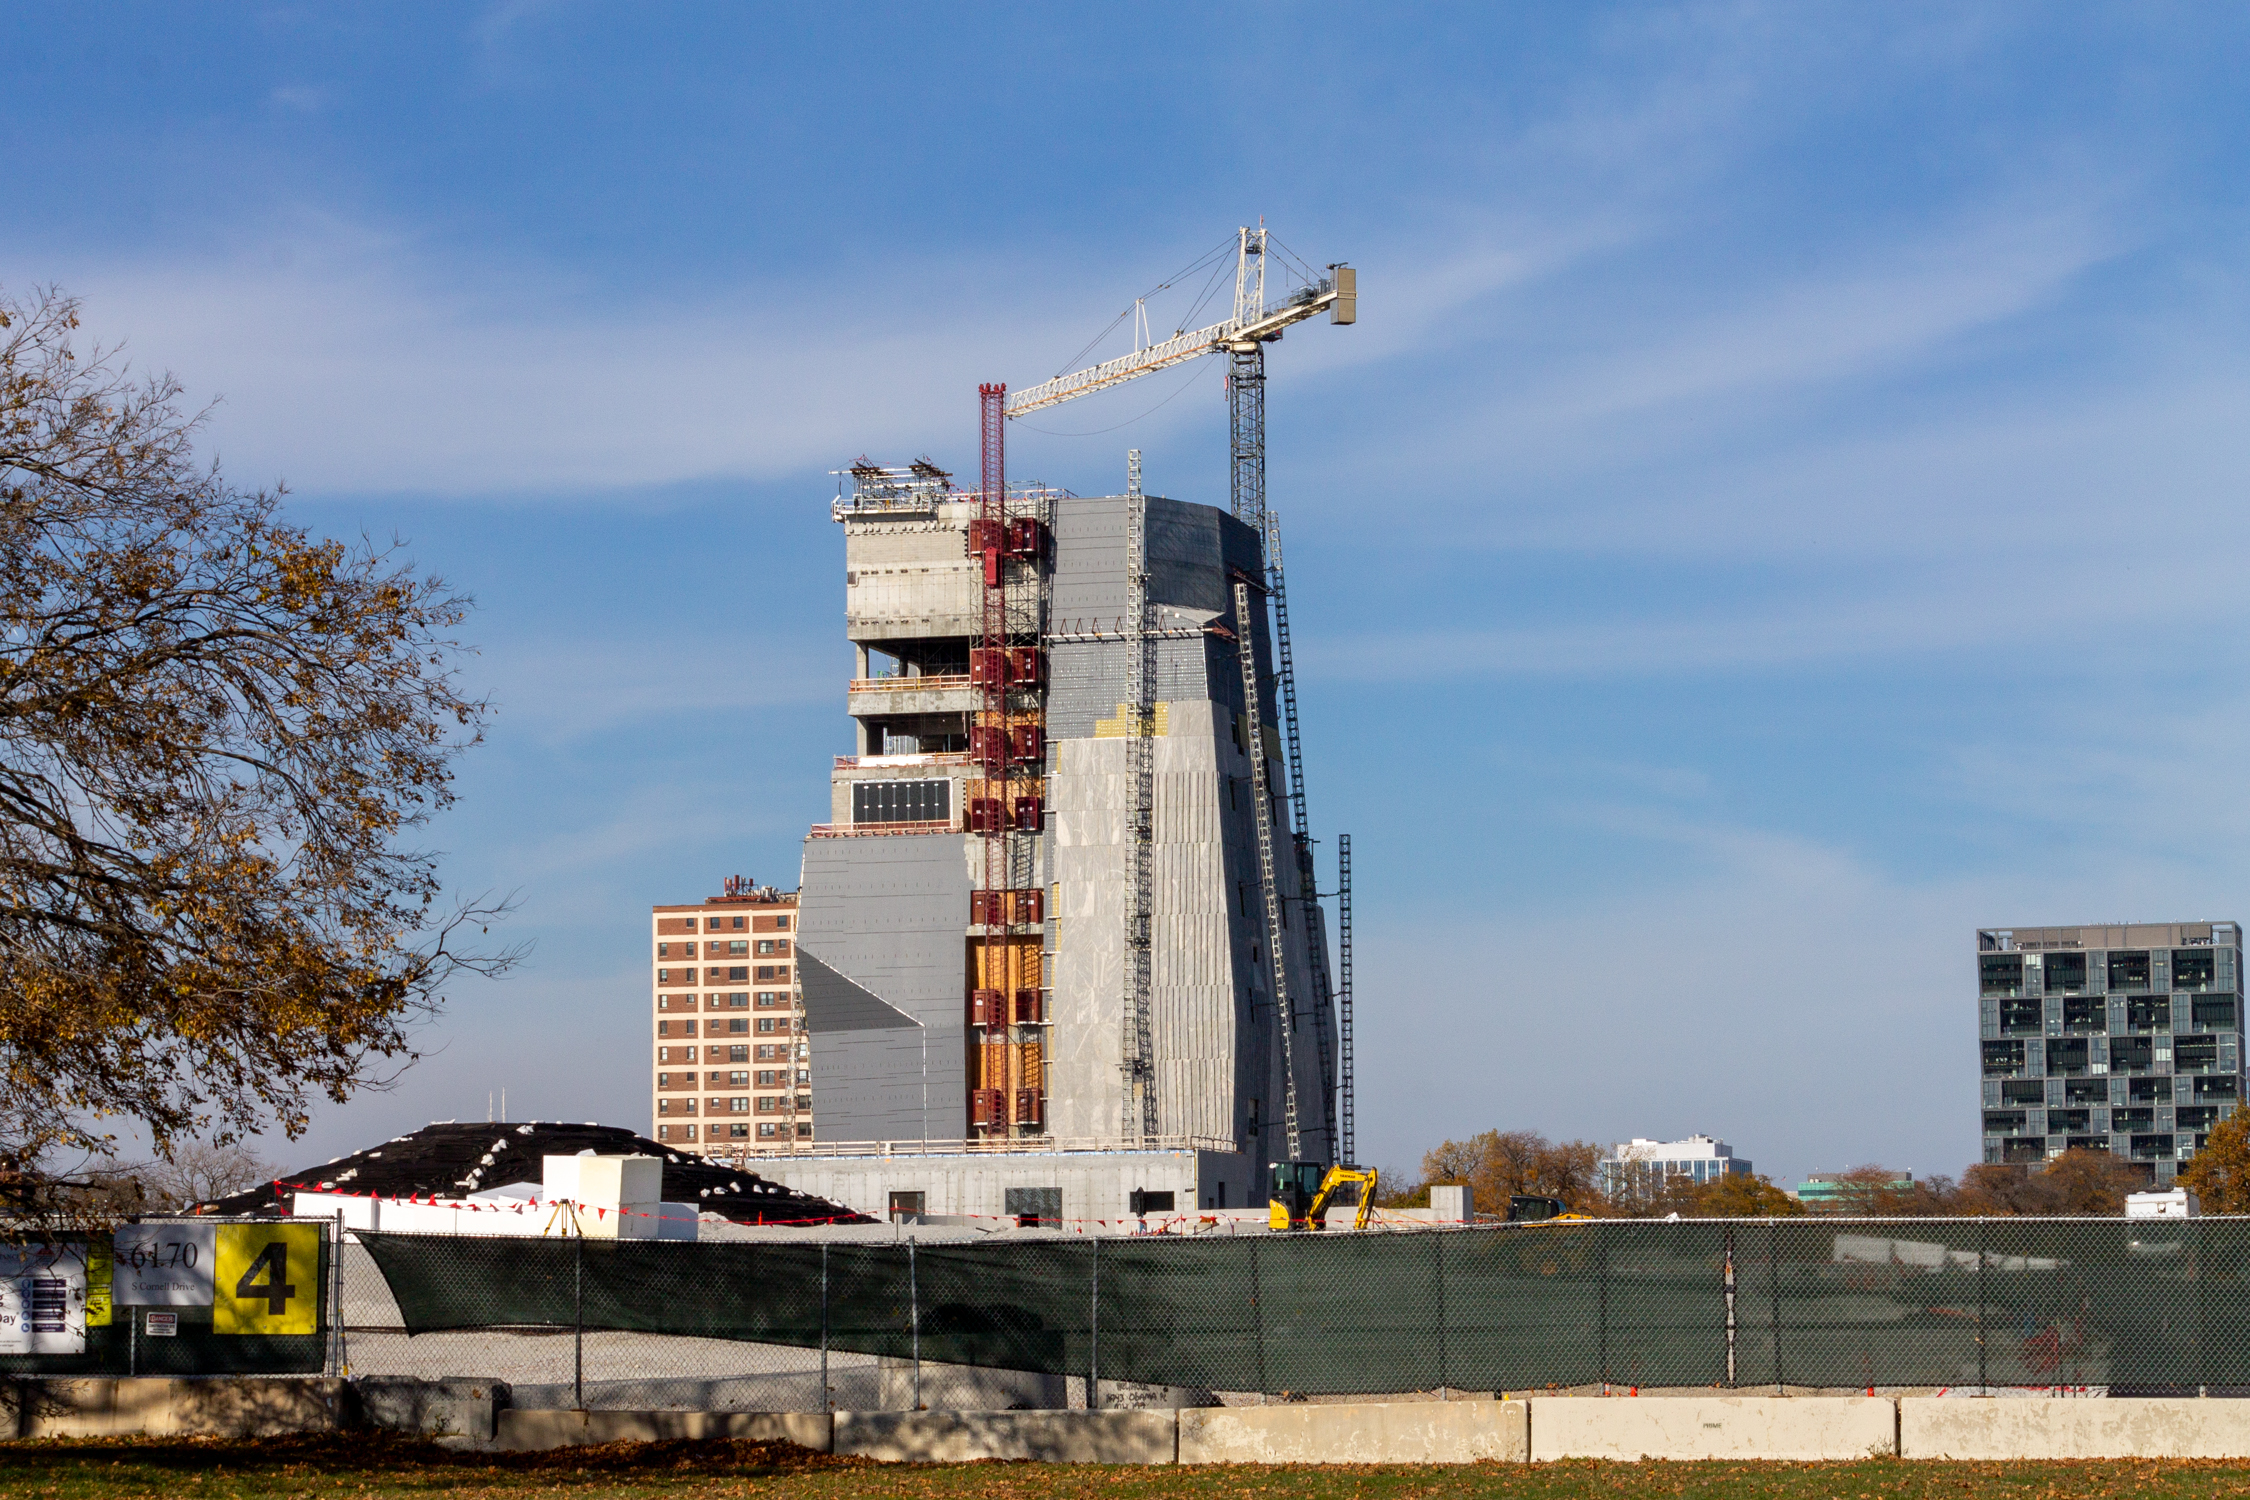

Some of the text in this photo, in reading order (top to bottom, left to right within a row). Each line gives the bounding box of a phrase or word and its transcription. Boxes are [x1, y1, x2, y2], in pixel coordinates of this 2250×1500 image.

[131, 1242, 198, 1269] 6170
[131, 1282, 195, 1291] S Cornell Drive
[236, 1242, 295, 1315] 4
